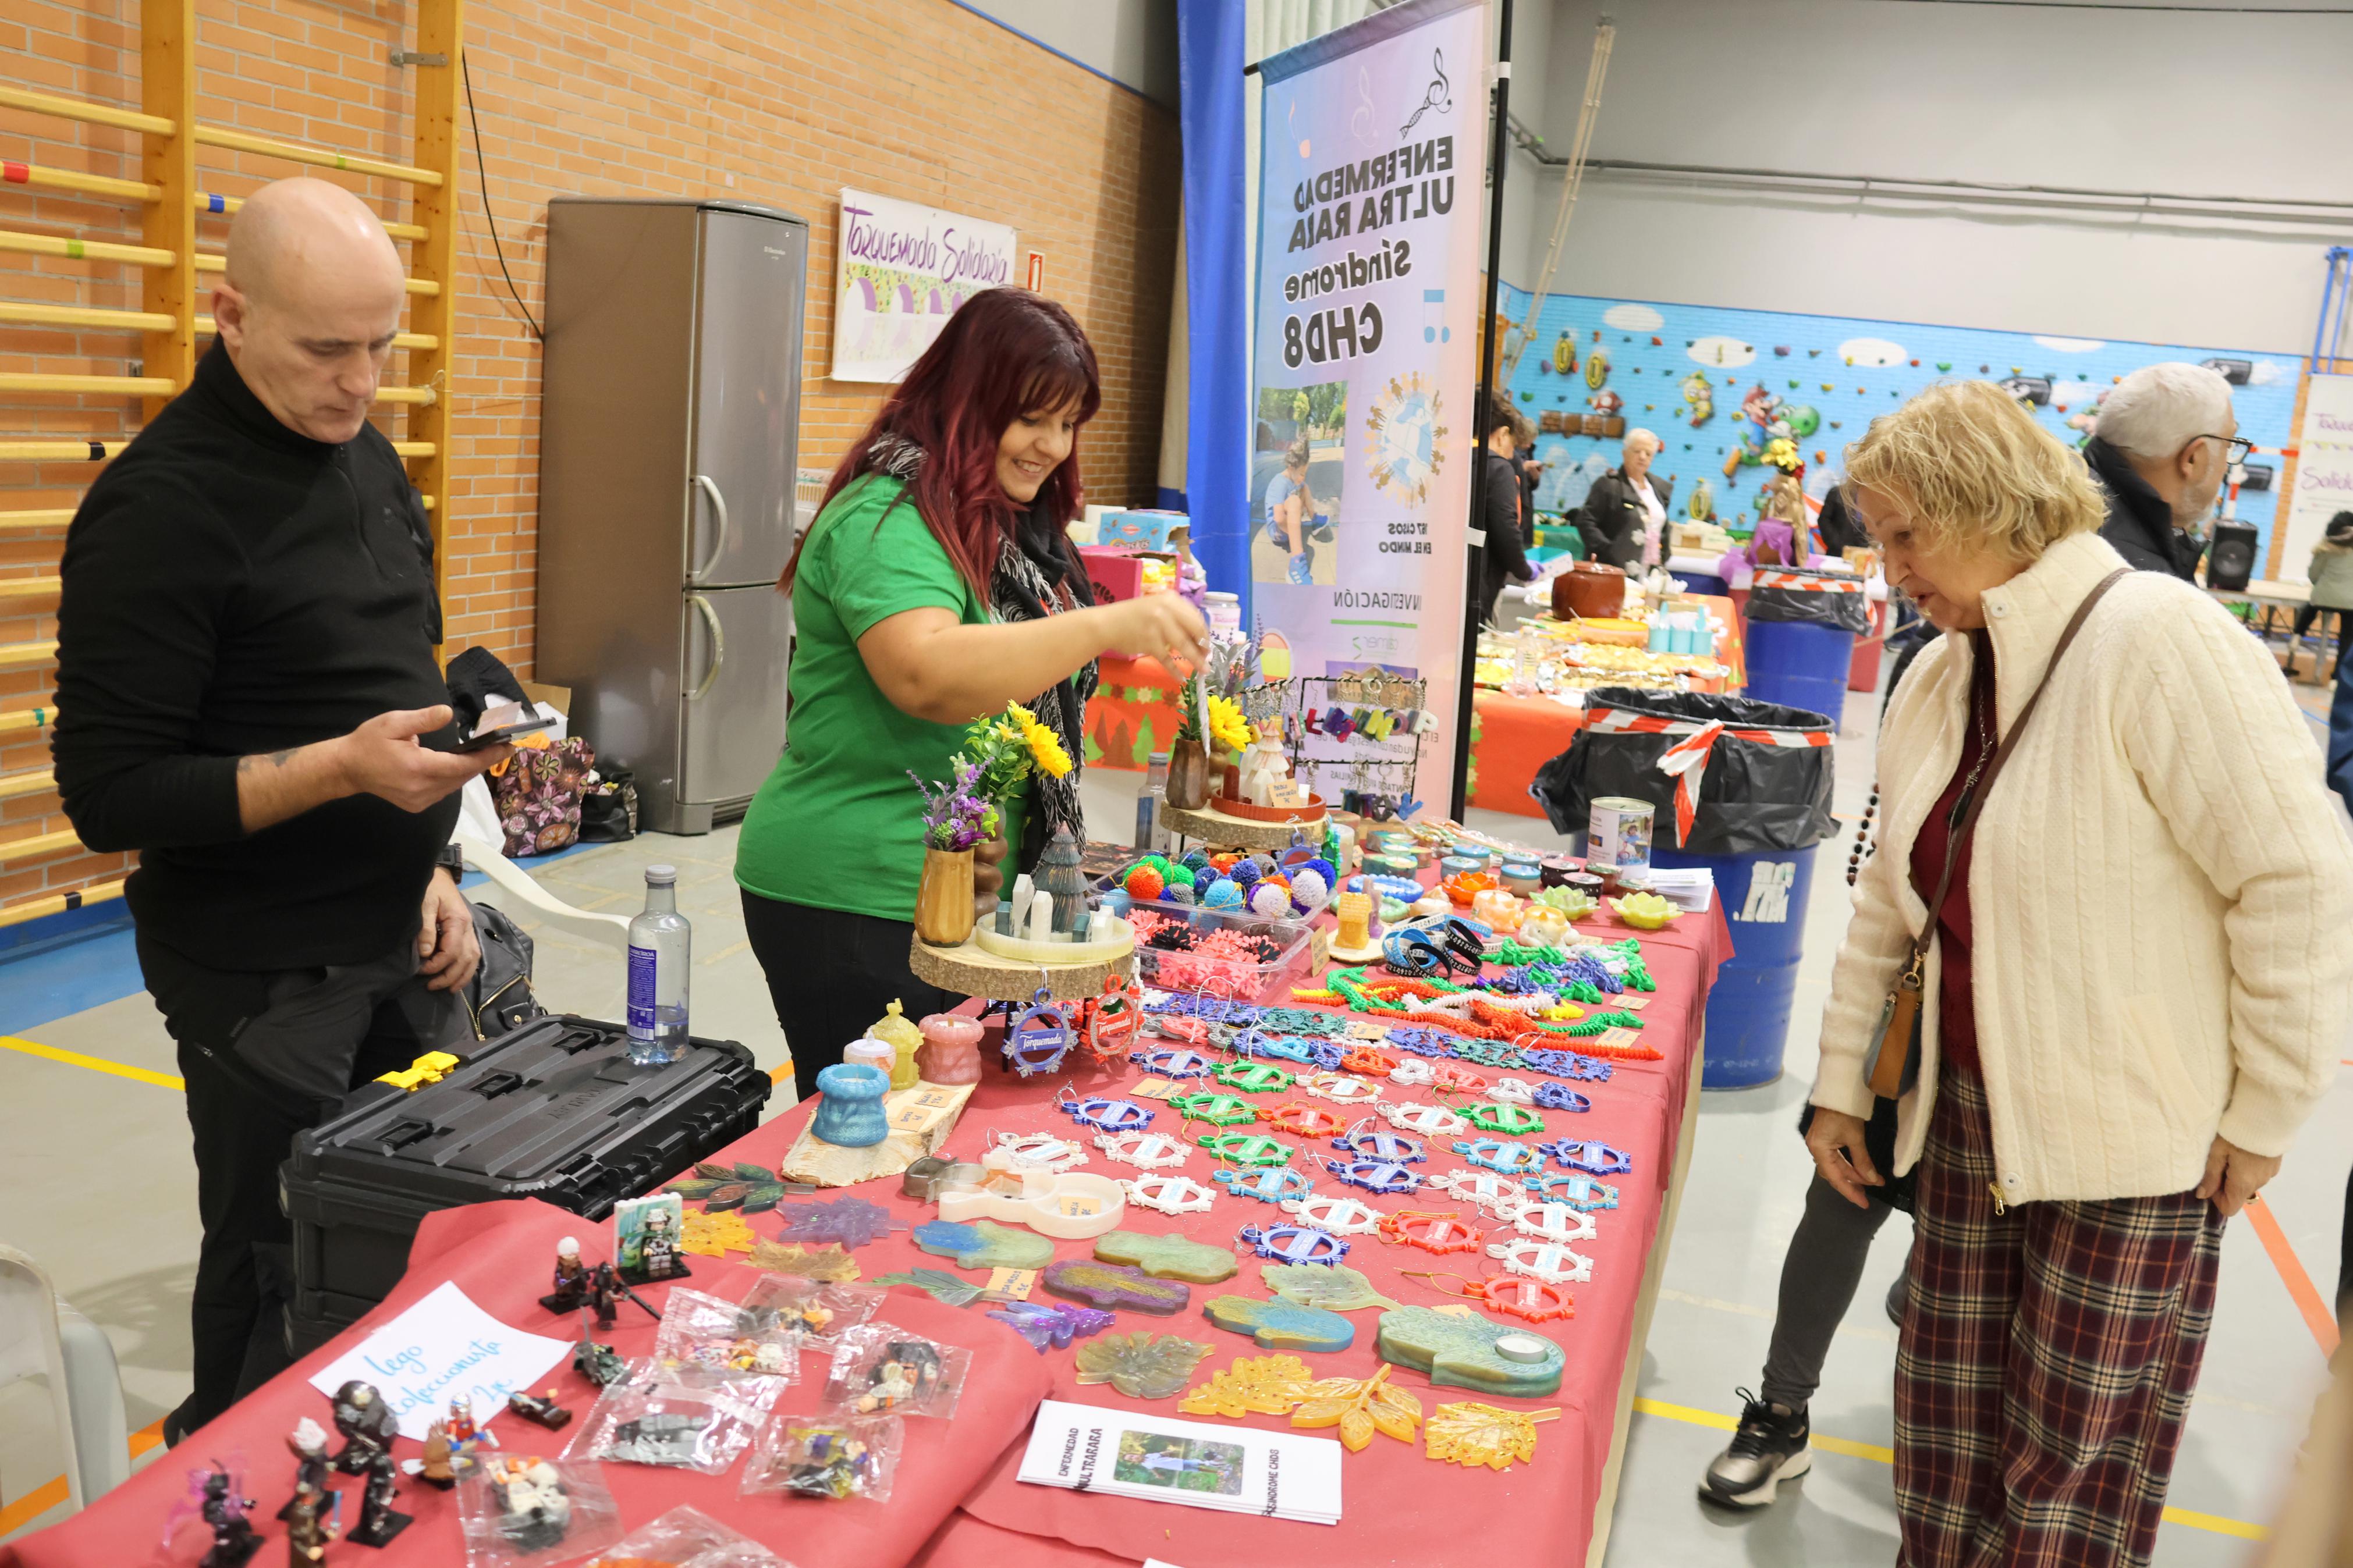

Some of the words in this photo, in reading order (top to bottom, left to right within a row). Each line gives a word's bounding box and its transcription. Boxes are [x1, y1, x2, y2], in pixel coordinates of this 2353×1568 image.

[1095, 1016, 1131, 1036] Torquemada
[1019, 1033, 1062, 1050] Torquemada
[1058, 1427, 1079, 1477] ENFERMEDAD
